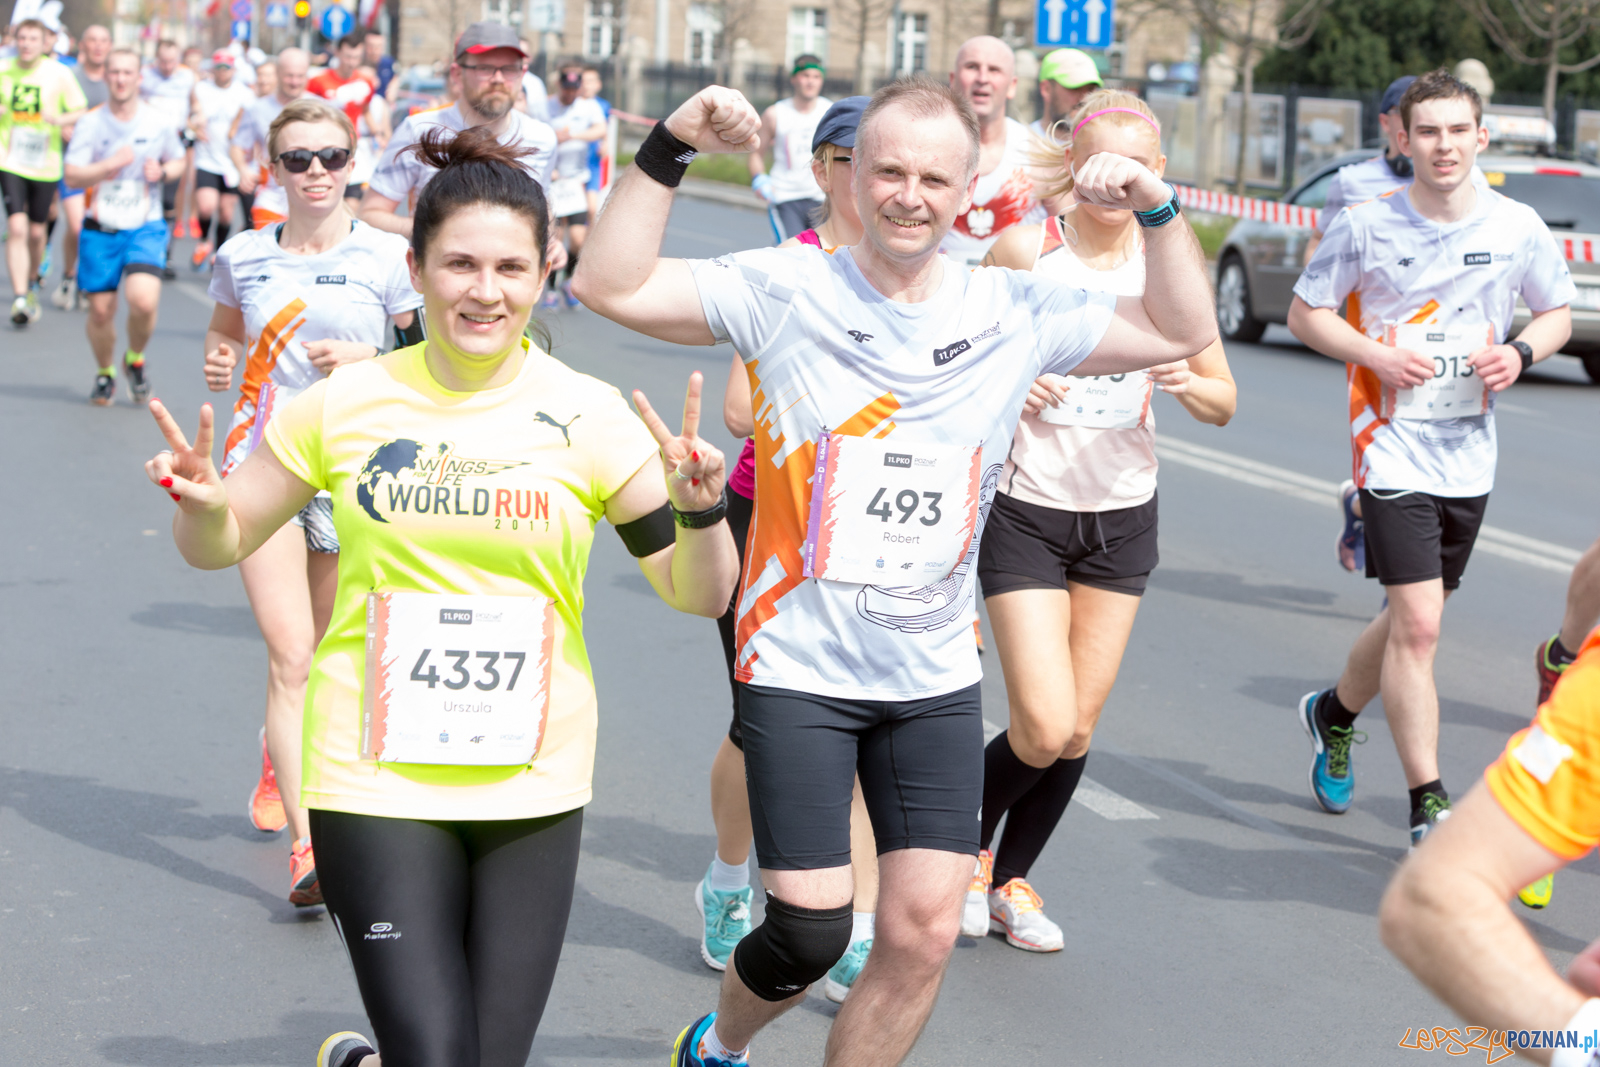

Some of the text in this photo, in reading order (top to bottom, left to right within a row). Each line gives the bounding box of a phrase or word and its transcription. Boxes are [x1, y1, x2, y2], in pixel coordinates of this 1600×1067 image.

[1085, 387, 1108, 396] Anna
[418, 453, 487, 474] WINGS
[425, 471, 467, 486] LIFE
[387, 483, 549, 520] WORLD RUN
[866, 487, 943, 527] 493
[494, 518, 549, 532] 2017
[882, 531, 921, 545] Robert
[410, 648, 526, 691] 4337
[443, 701, 492, 713] Urszula
[364, 931, 402, 940] Kalenji
